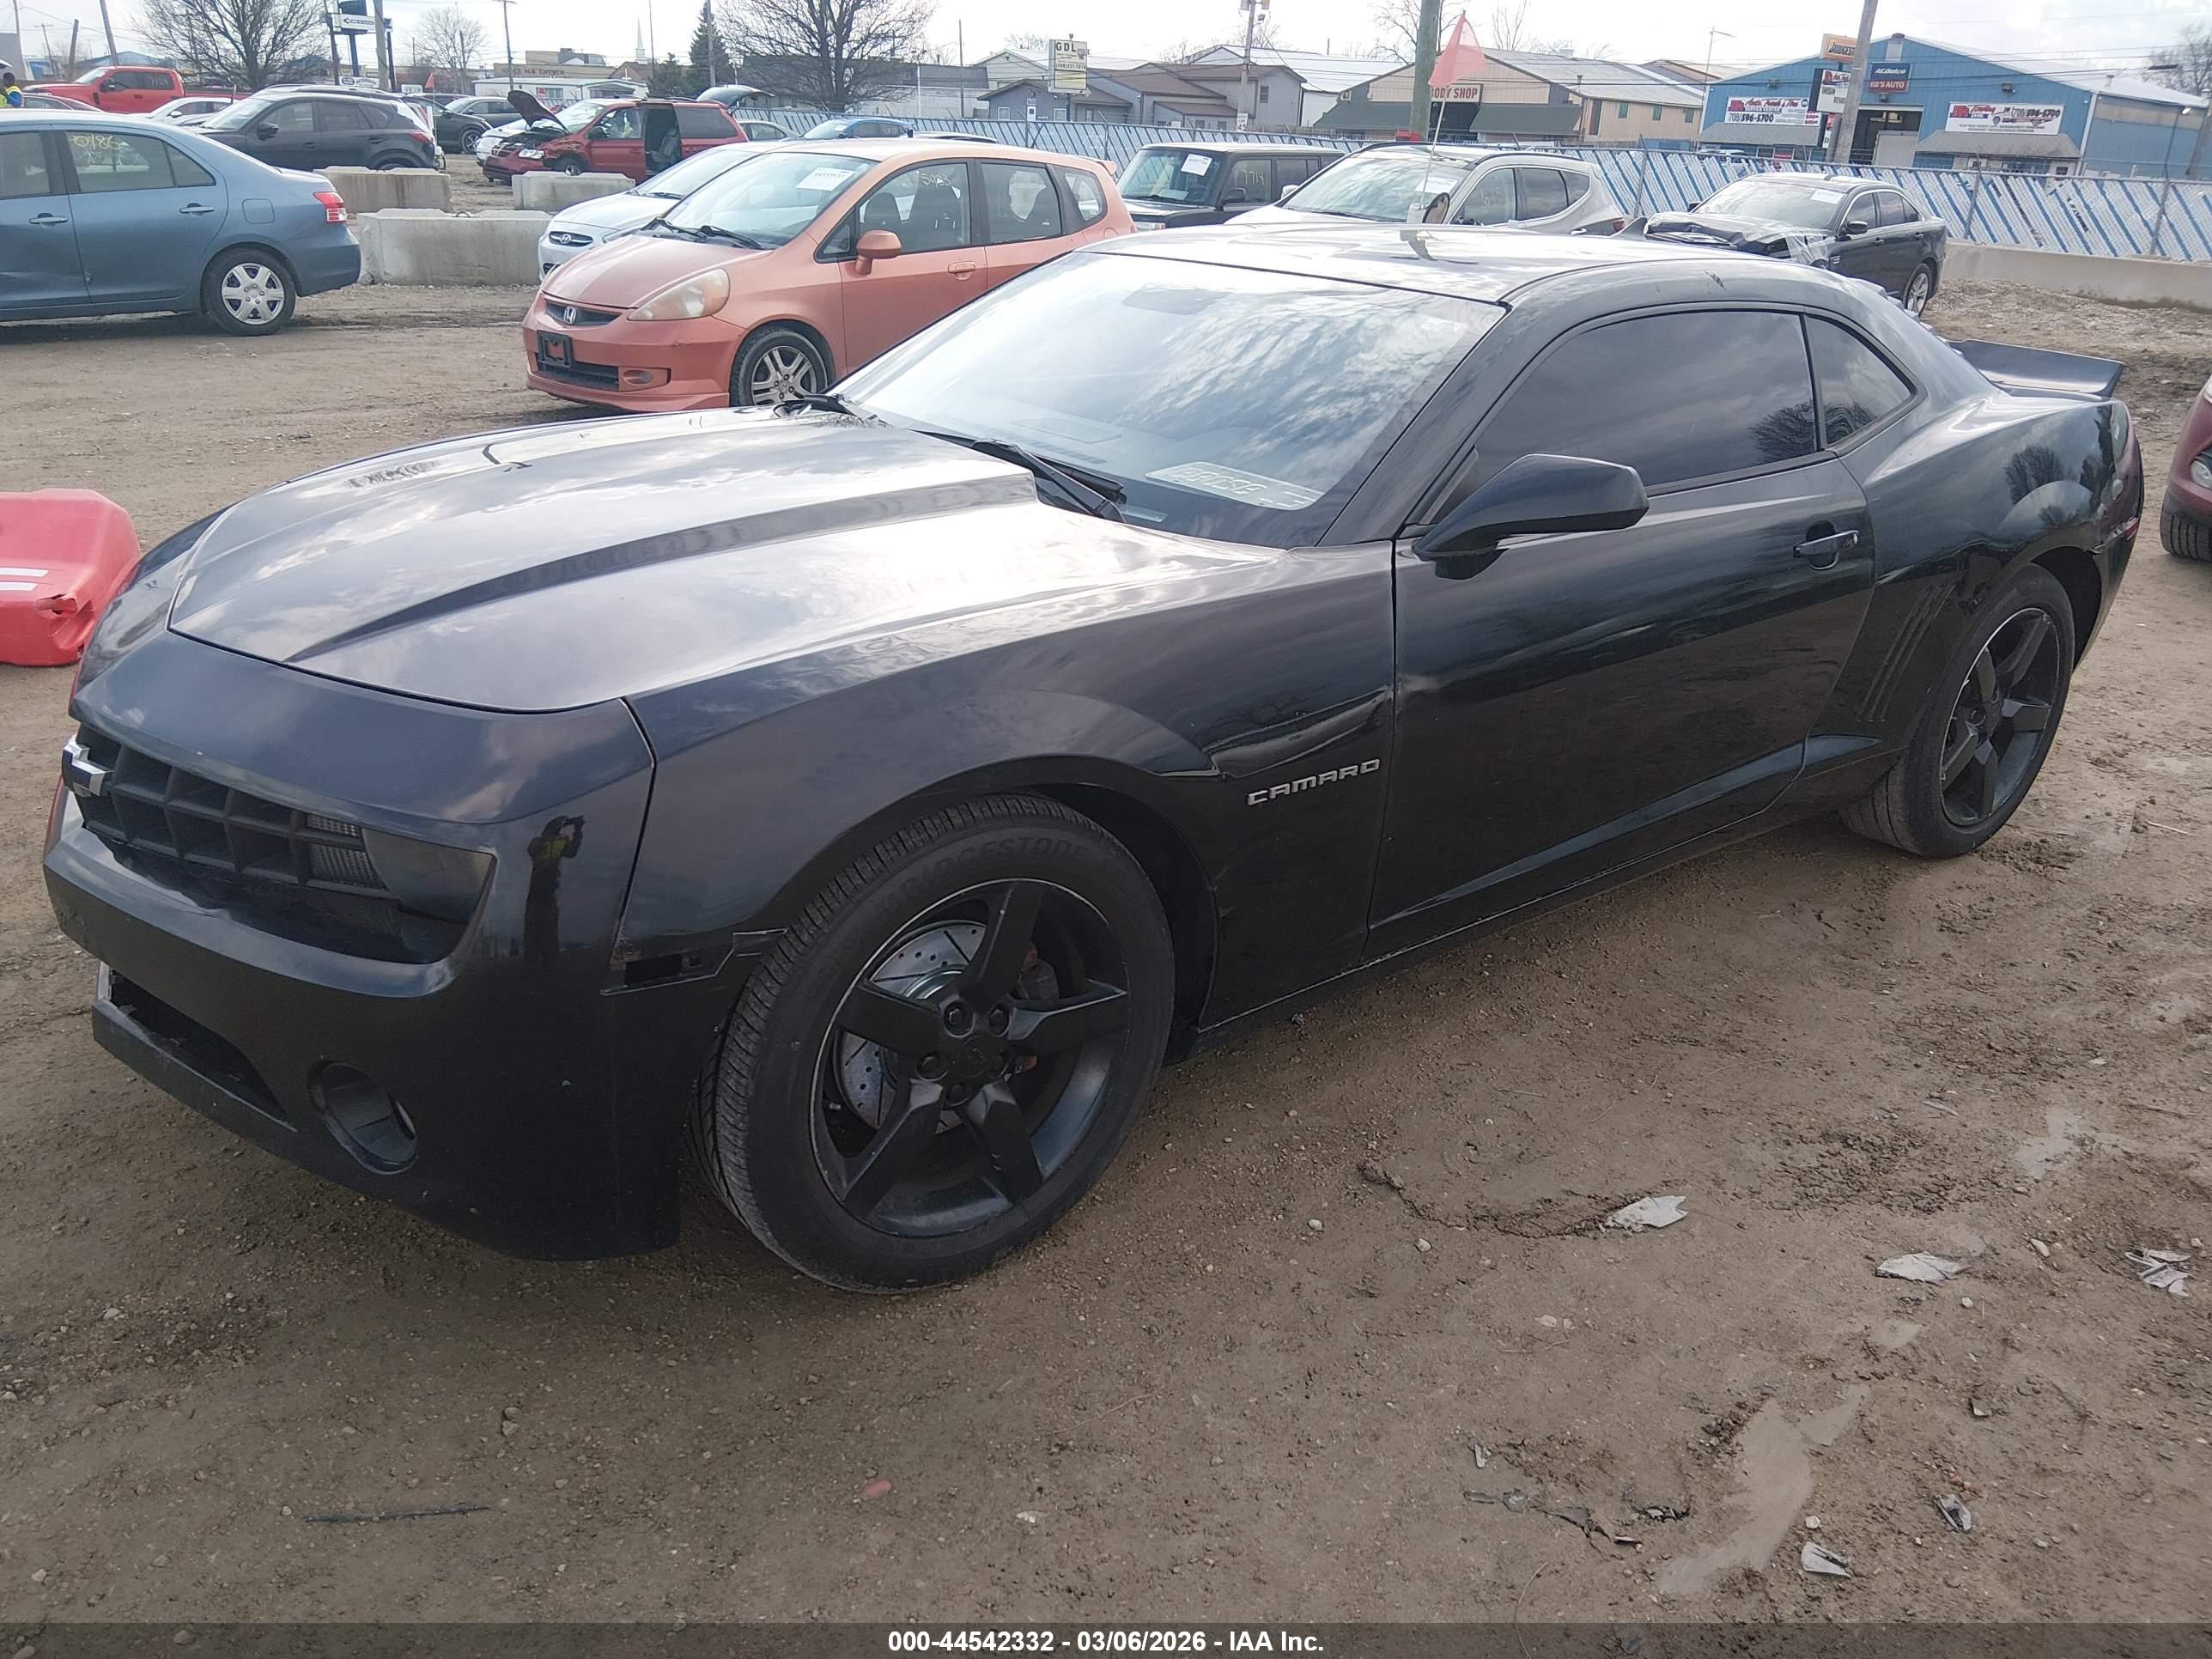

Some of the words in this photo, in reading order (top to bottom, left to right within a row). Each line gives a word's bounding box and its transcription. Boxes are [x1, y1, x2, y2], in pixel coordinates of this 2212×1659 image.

[1056, 41, 1076, 52] GDL
[1885, 81, 1905, 89] AUTO
[1431, 88, 1452, 99] ODY
[1453, 88, 1478, 99] SHOP
[1247, 758, 1381, 806] CAMARO
